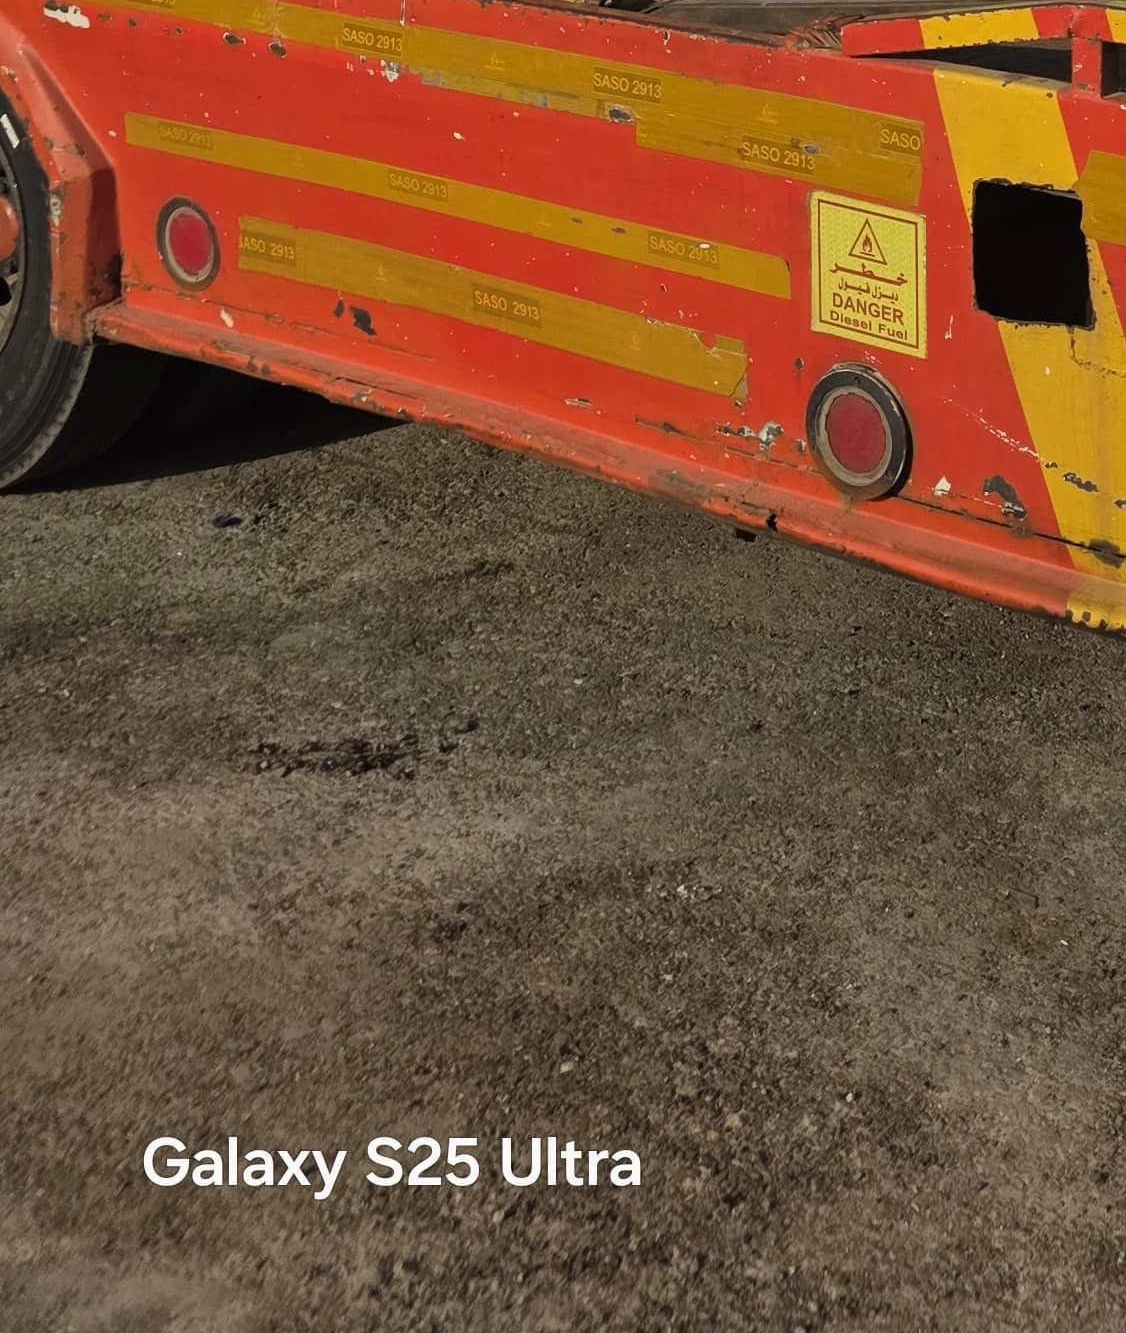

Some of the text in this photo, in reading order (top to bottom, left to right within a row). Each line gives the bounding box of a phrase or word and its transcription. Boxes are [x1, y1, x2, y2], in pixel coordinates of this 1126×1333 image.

[342, 28, 402, 51] SASO 2913
[593, 72, 662, 99] SASO 2913
[880, 129, 921, 151] SASO
[742, 141, 816, 170] SASO 2913
[389, 173, 448, 199] SASO 2913
[270, 243, 296, 260] 2913
[649, 236, 718, 264] SASO 2913
[829, 263, 907, 286] خطر
[474, 290, 539, 321] SASO 2913
[872, 286, 899, 304] ديزل
[832, 292, 904, 326] DANGER
[830, 310, 908, 340] Diesel Fuel
